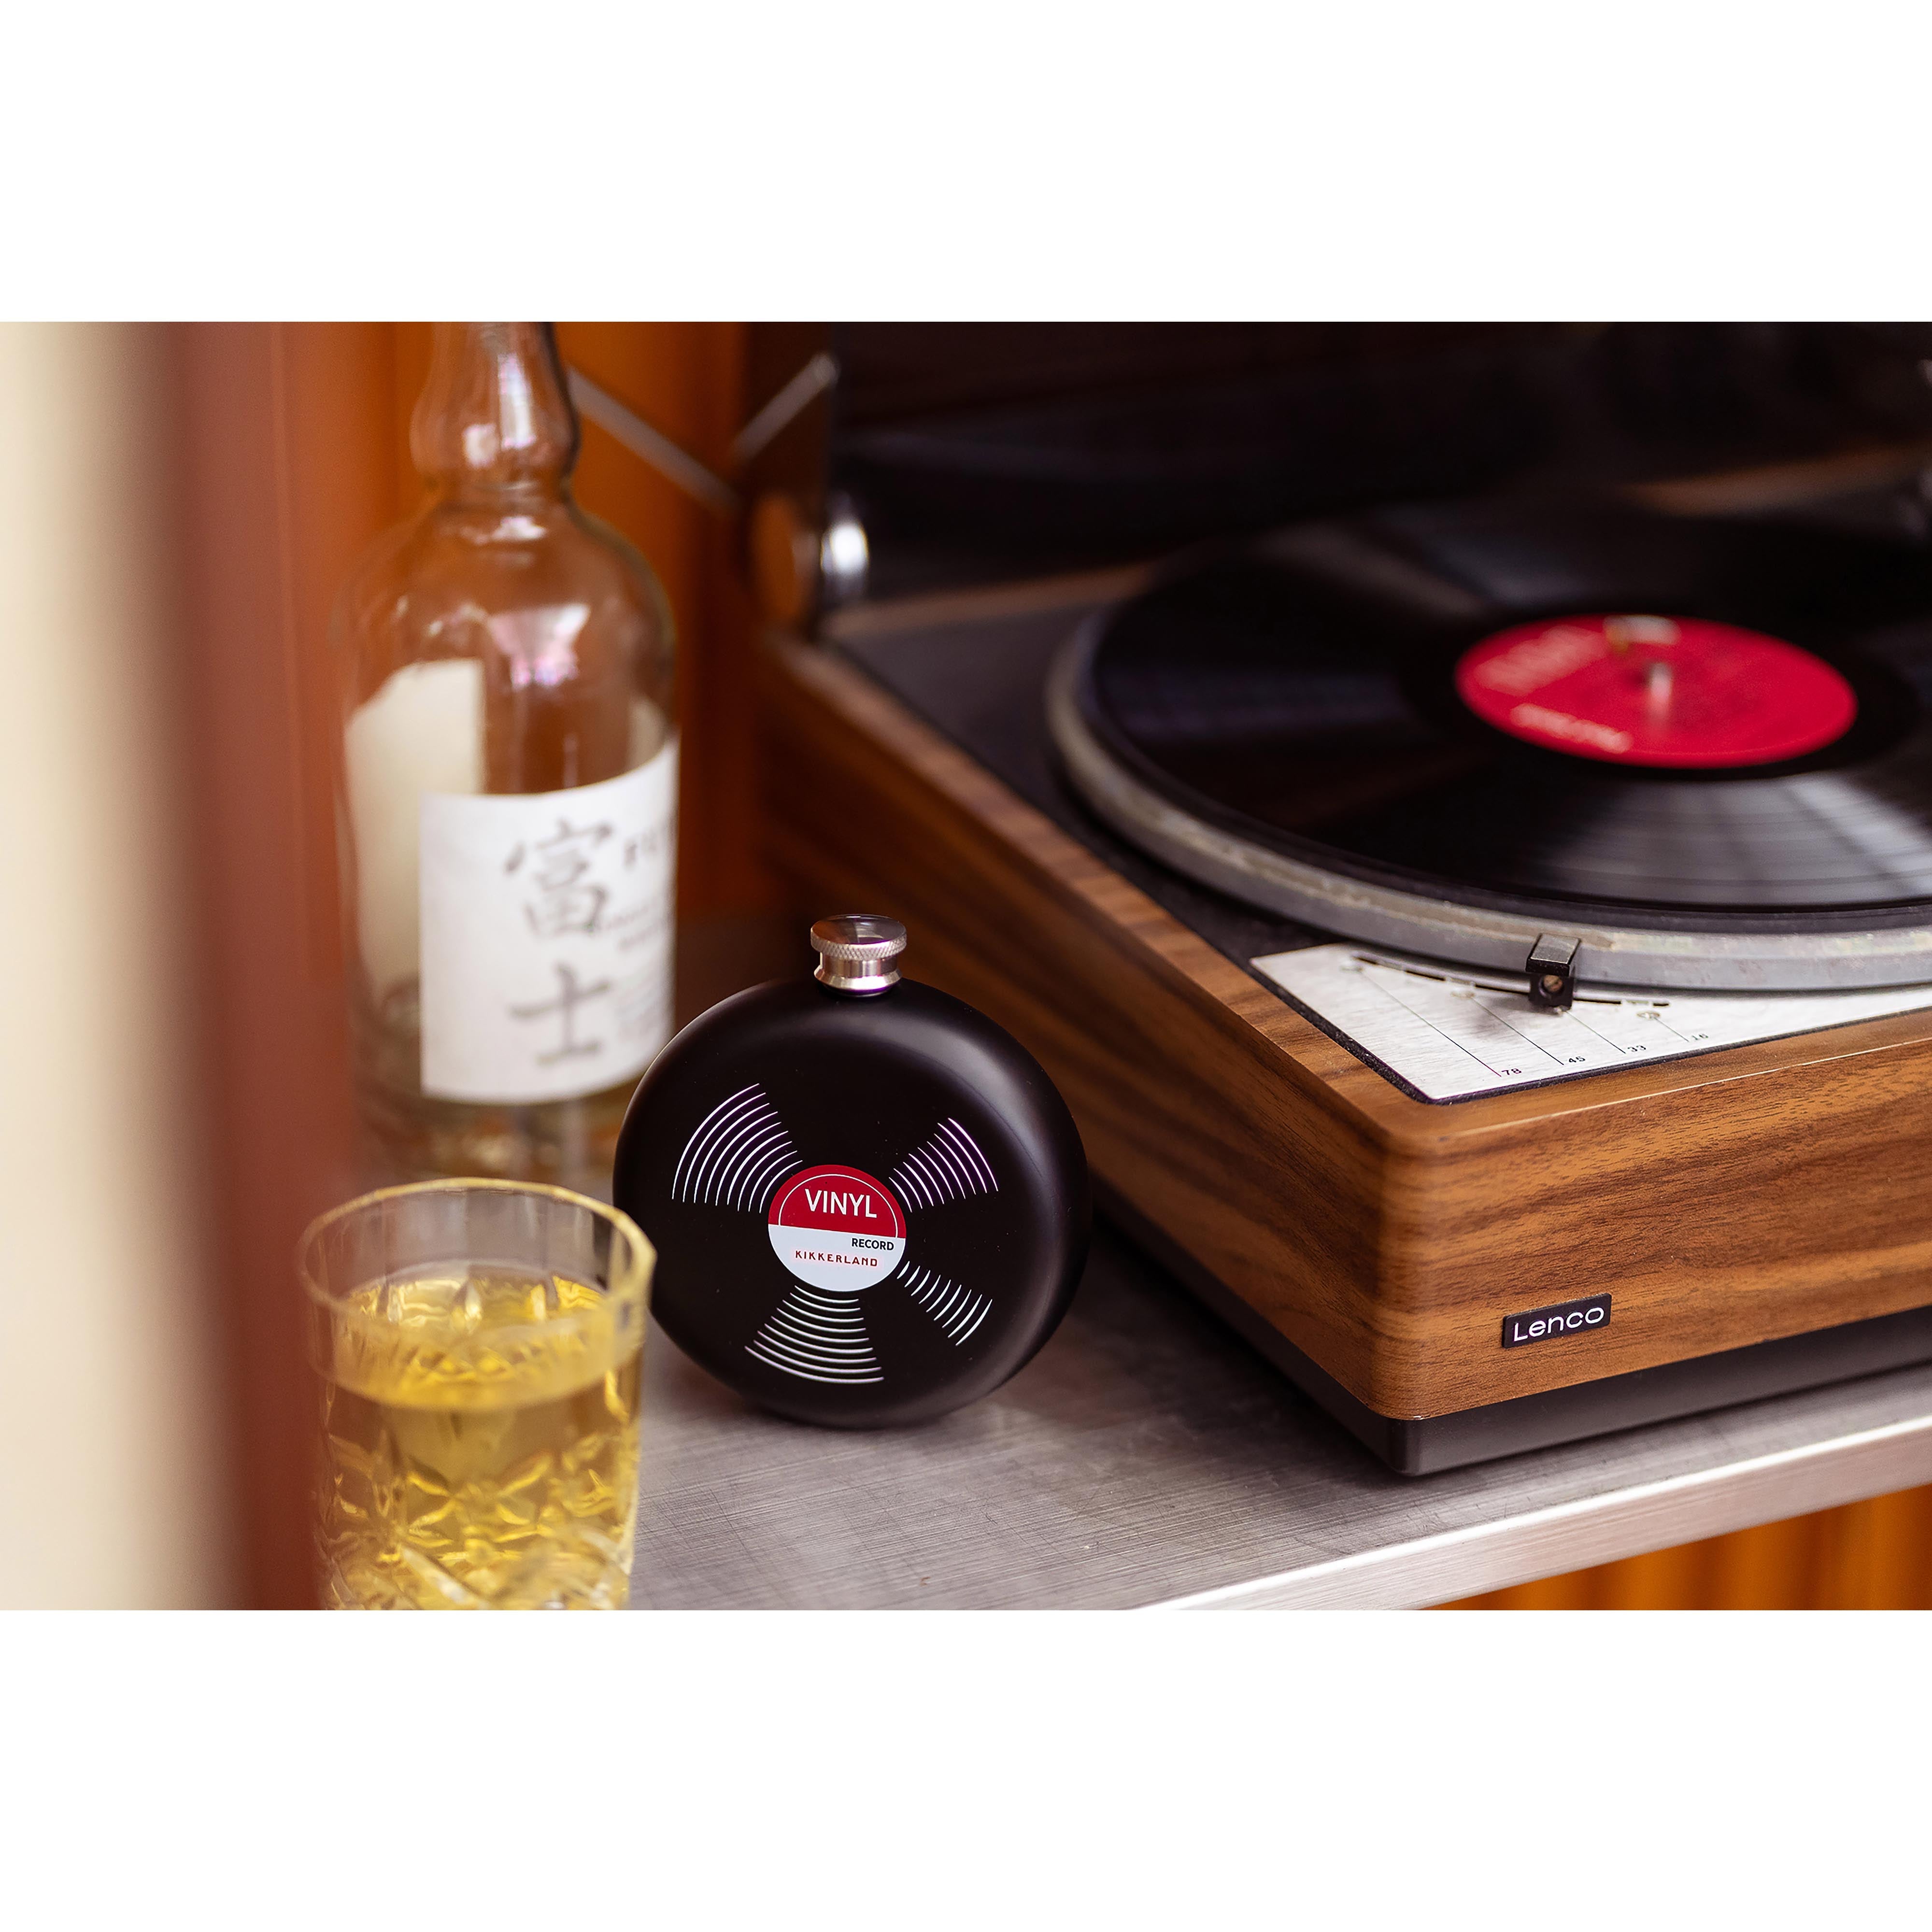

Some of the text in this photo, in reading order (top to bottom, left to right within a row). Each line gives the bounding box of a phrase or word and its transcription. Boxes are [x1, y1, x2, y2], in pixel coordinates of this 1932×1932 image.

[1627, 1044, 1646, 1052] 33
[805, 1188, 877, 1218] VINYL
[852, 1237, 894, 1250] RECORD
[796, 1250, 878, 1266] KIKKERLAND
[1514, 1307, 1604, 1341] Lenco
